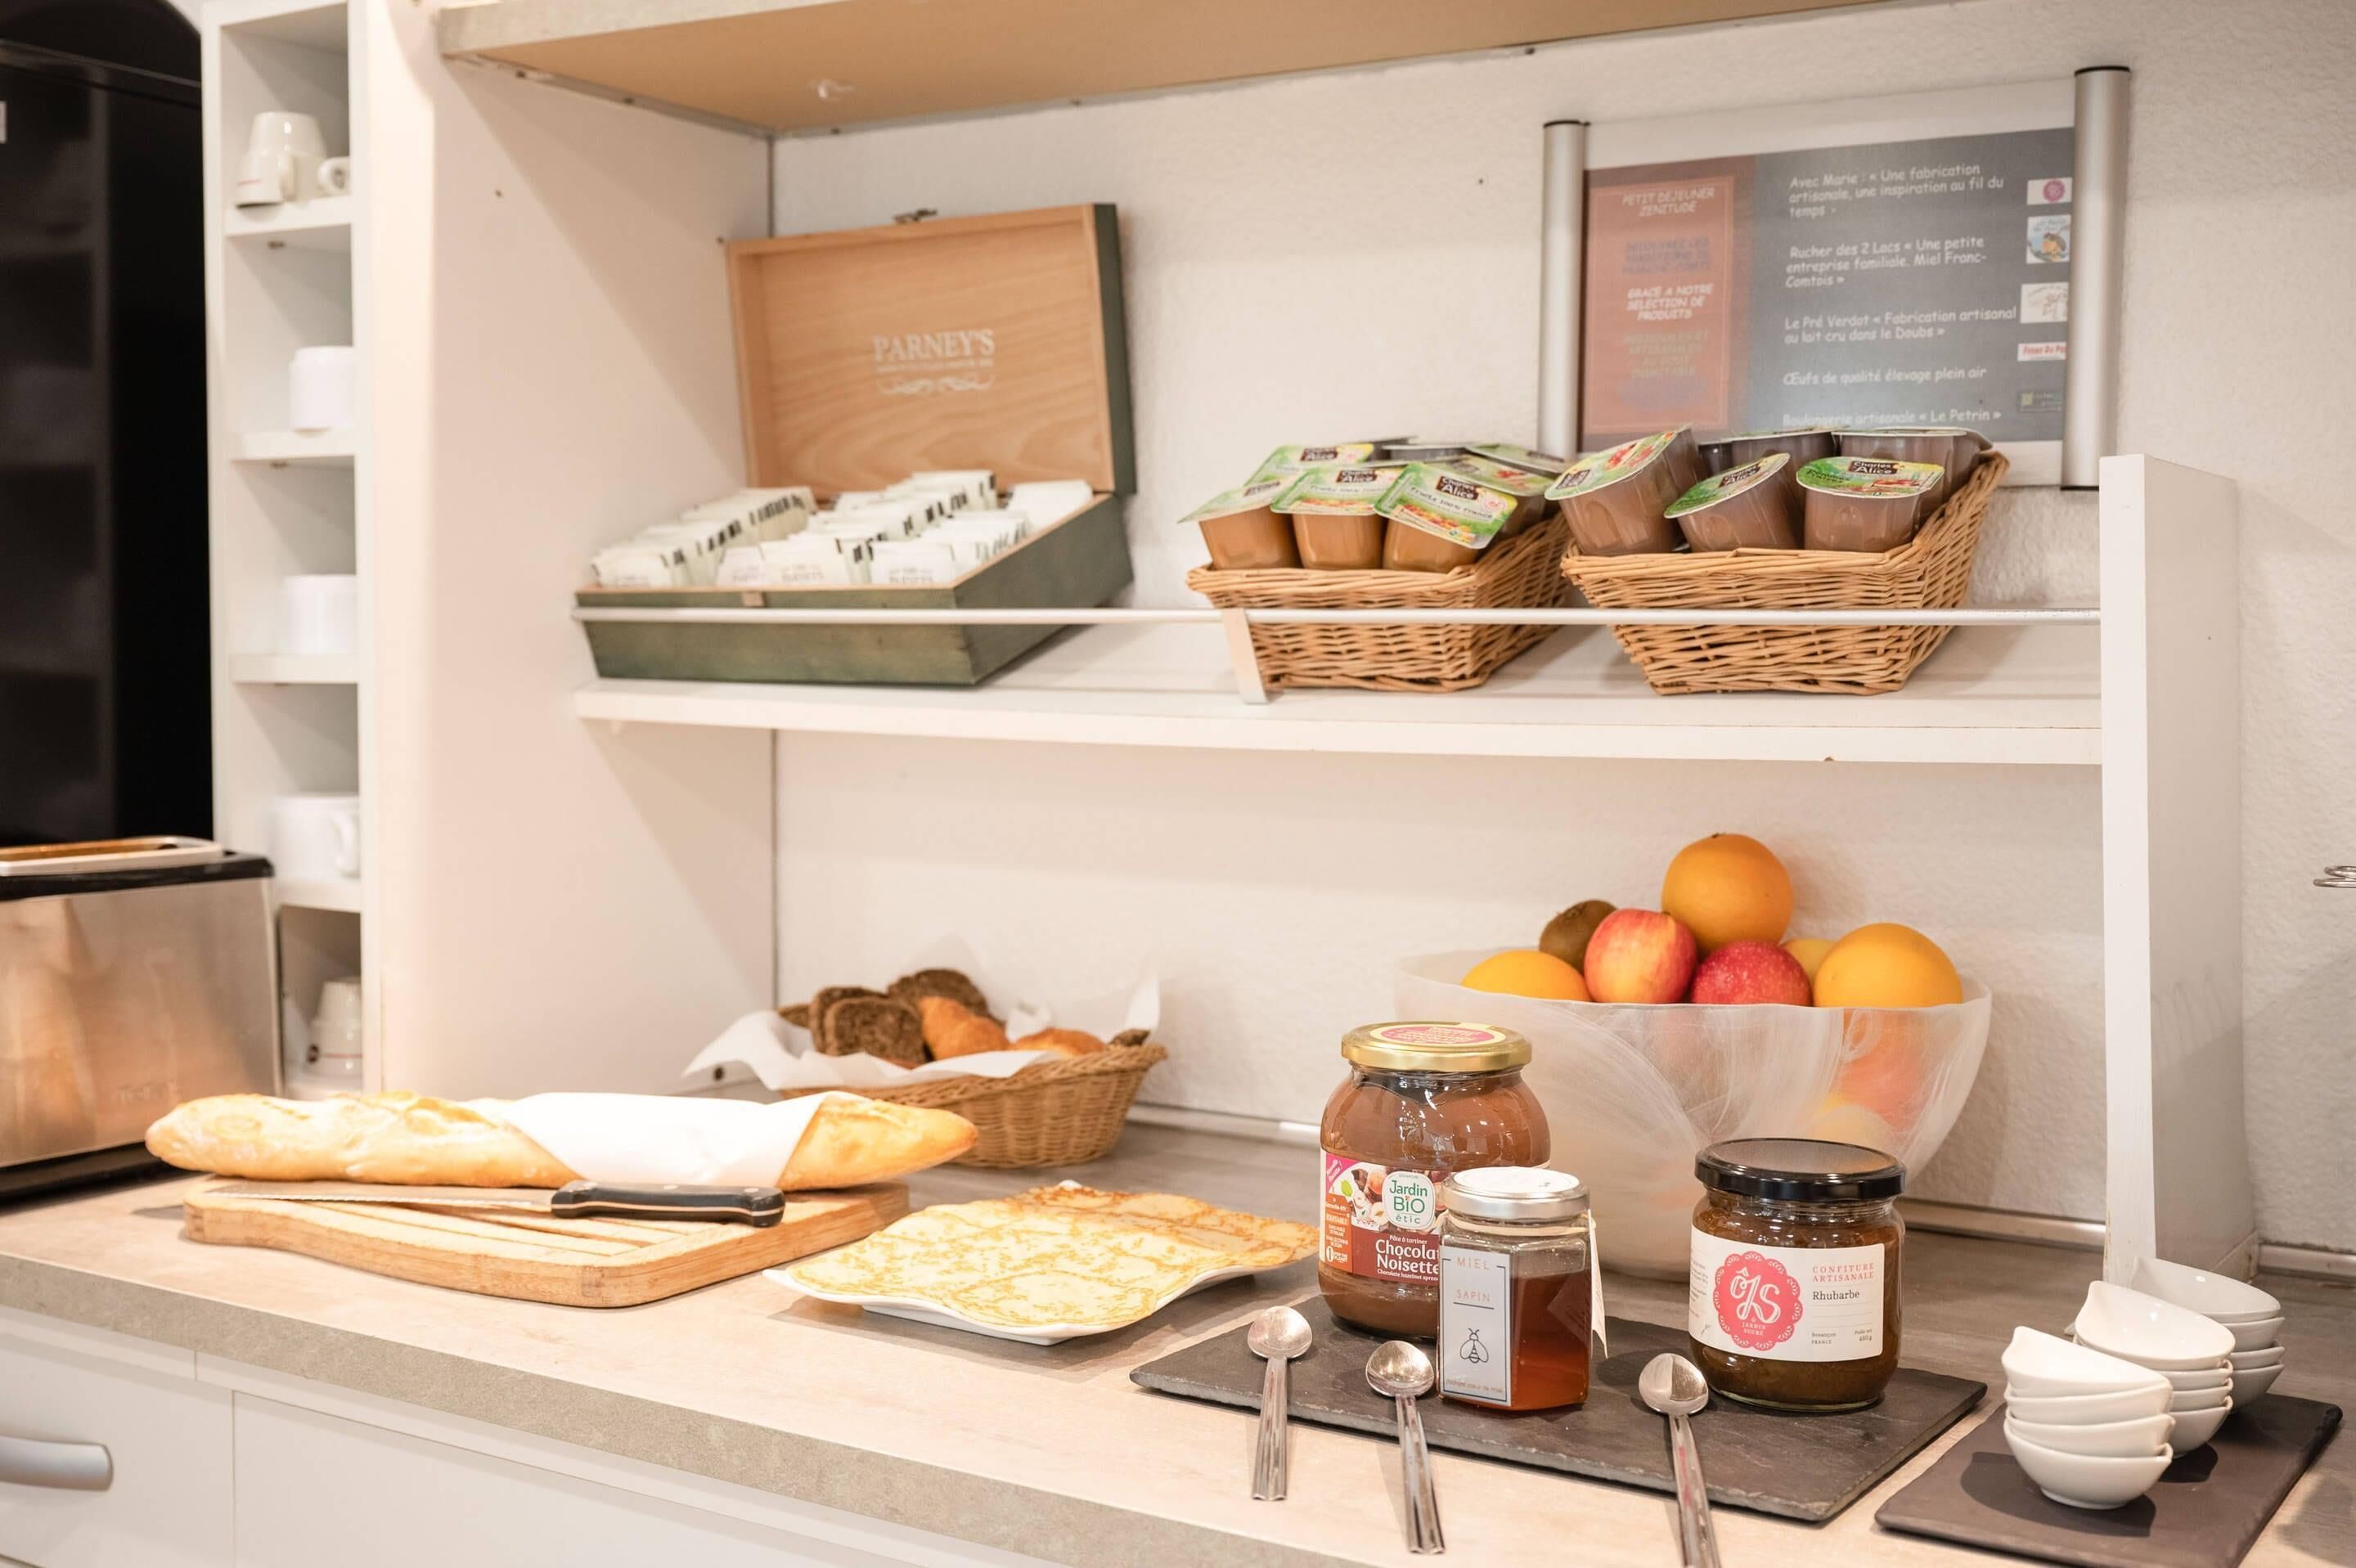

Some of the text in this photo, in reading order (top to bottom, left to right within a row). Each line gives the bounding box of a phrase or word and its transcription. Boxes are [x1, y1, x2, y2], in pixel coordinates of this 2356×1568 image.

[1789, 176, 1819, 189] Avec
[1823, 173, 1859, 186] Marie
[1880, 168, 1906, 182] Une
[1909, 163, 1981, 181] fabrication
[1855, 188, 1877, 199] une
[1880, 181, 1948, 199] inspiration
[1949, 182, 1965, 192] au
[1969, 176, 1984, 190] fil
[1987, 175, 2004, 189] du
[1789, 205, 1826, 219] temps
[1789, 245, 1833, 259] Rucher
[1835, 243, 1858, 257] des
[1860, 241, 1870, 254] 2
[1873, 241, 1901, 254] Lacs
[1915, 238, 1941, 252] Une
[1944, 236, 1985, 252] petite
[1786, 259, 1850, 275] entreprise
[1913, 251, 1942, 267] Miel
[1944, 250, 1988, 264] Franc-
[1785, 275, 1834, 289] Comtois
[1784, 317, 1801, 330] Le
[1802, 314, 1824, 329] Pré
[1826, 314, 1870, 329] Verdot
[1883, 309, 1957, 325] Fabrication
[1958, 306, 2017, 321] artisanal
[1784, 334, 1799, 345] au
[1802, 330, 1823, 344] lait
[1825, 330, 1846, 342] cru
[1849, 329, 1877, 341] dans
[1880, 327, 1893, 340] le
[1895, 326, 1934, 339] Doubs
[1822, 371, 1838, 384] de
[1841, 369, 1882, 386] qualité
[1884, 367, 1931, 384] élevage
[1934, 366, 1965, 384] plein
[1967, 366, 1988, 379] air
[1854, 411, 1916, 425] artisanale
[1930, 411, 1947, 423] Le
[1855, 466, 1893, 475] Alice
[1441, 484, 1476, 500] Alice
[1389, 1179, 1428, 1197] Jardin
[1389, 1234, 1401, 1242] Pâte
[1406, 1237, 1428, 1245] tartiner
[1377, 1253, 1440, 1275] Noisette
[1456, 1256, 1490, 1270] MIEL
[1812, 1262, 1874, 1274] CONFITURE
[1377, 1268, 1401, 1277] Chocolate
[1401, 1272, 1423, 1280] hazelnut
[1812, 1271, 1874, 1283] ARTISANALE
[1456, 1289, 1491, 1302] SAPIN
[1812, 1289, 1860, 1301] Rhubarbe
[1742, 1322, 1767, 1330] JARDIN
